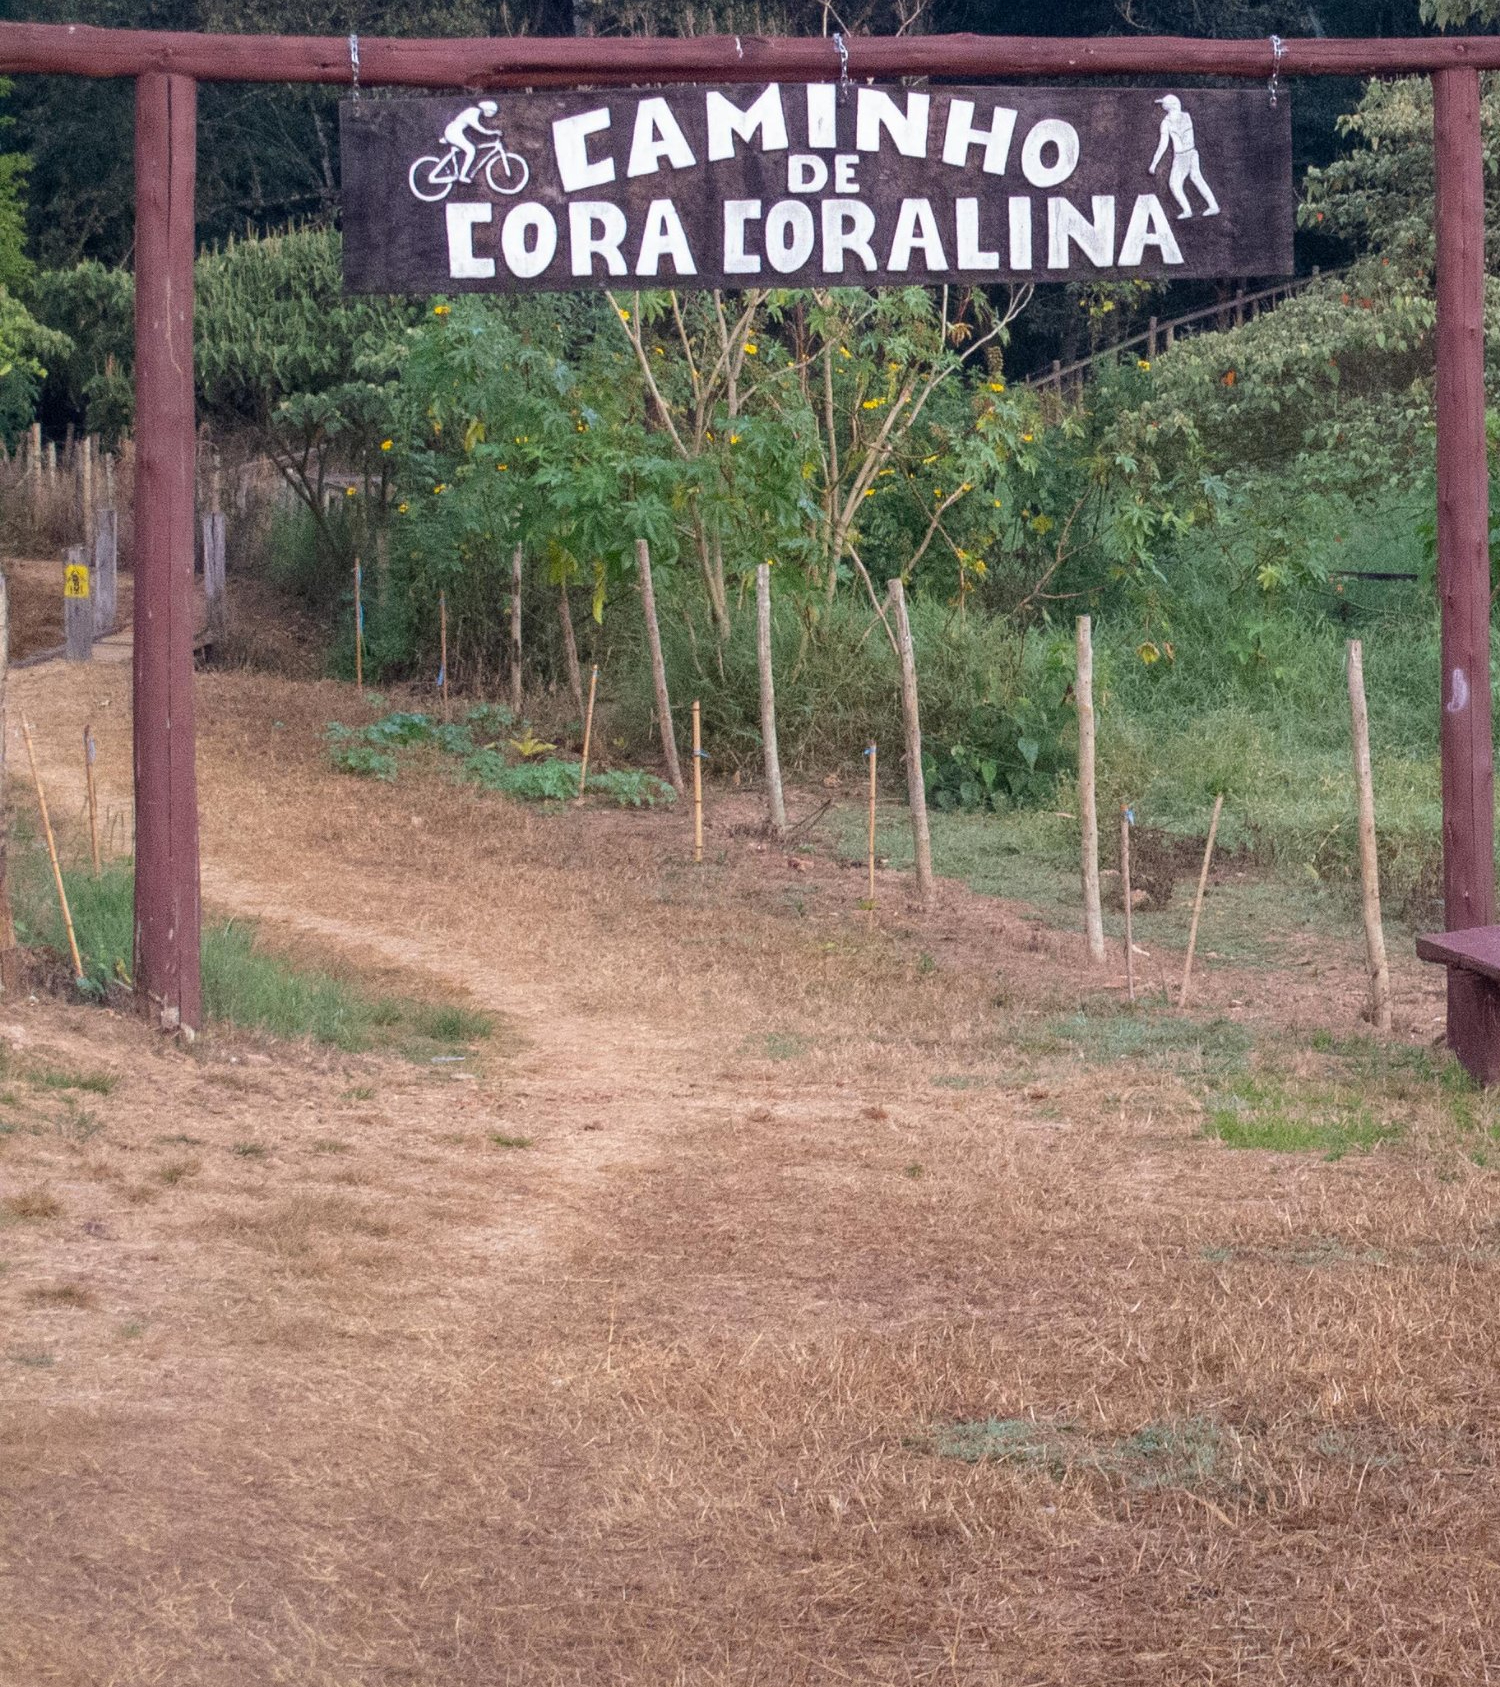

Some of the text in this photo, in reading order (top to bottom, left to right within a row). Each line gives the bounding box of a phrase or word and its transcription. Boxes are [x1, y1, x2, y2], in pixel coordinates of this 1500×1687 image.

[552, 83, 1079, 192] CAMINHO
[788, 153, 860, 194] DE
[446, 195, 1184, 279] CORA CORALINA
